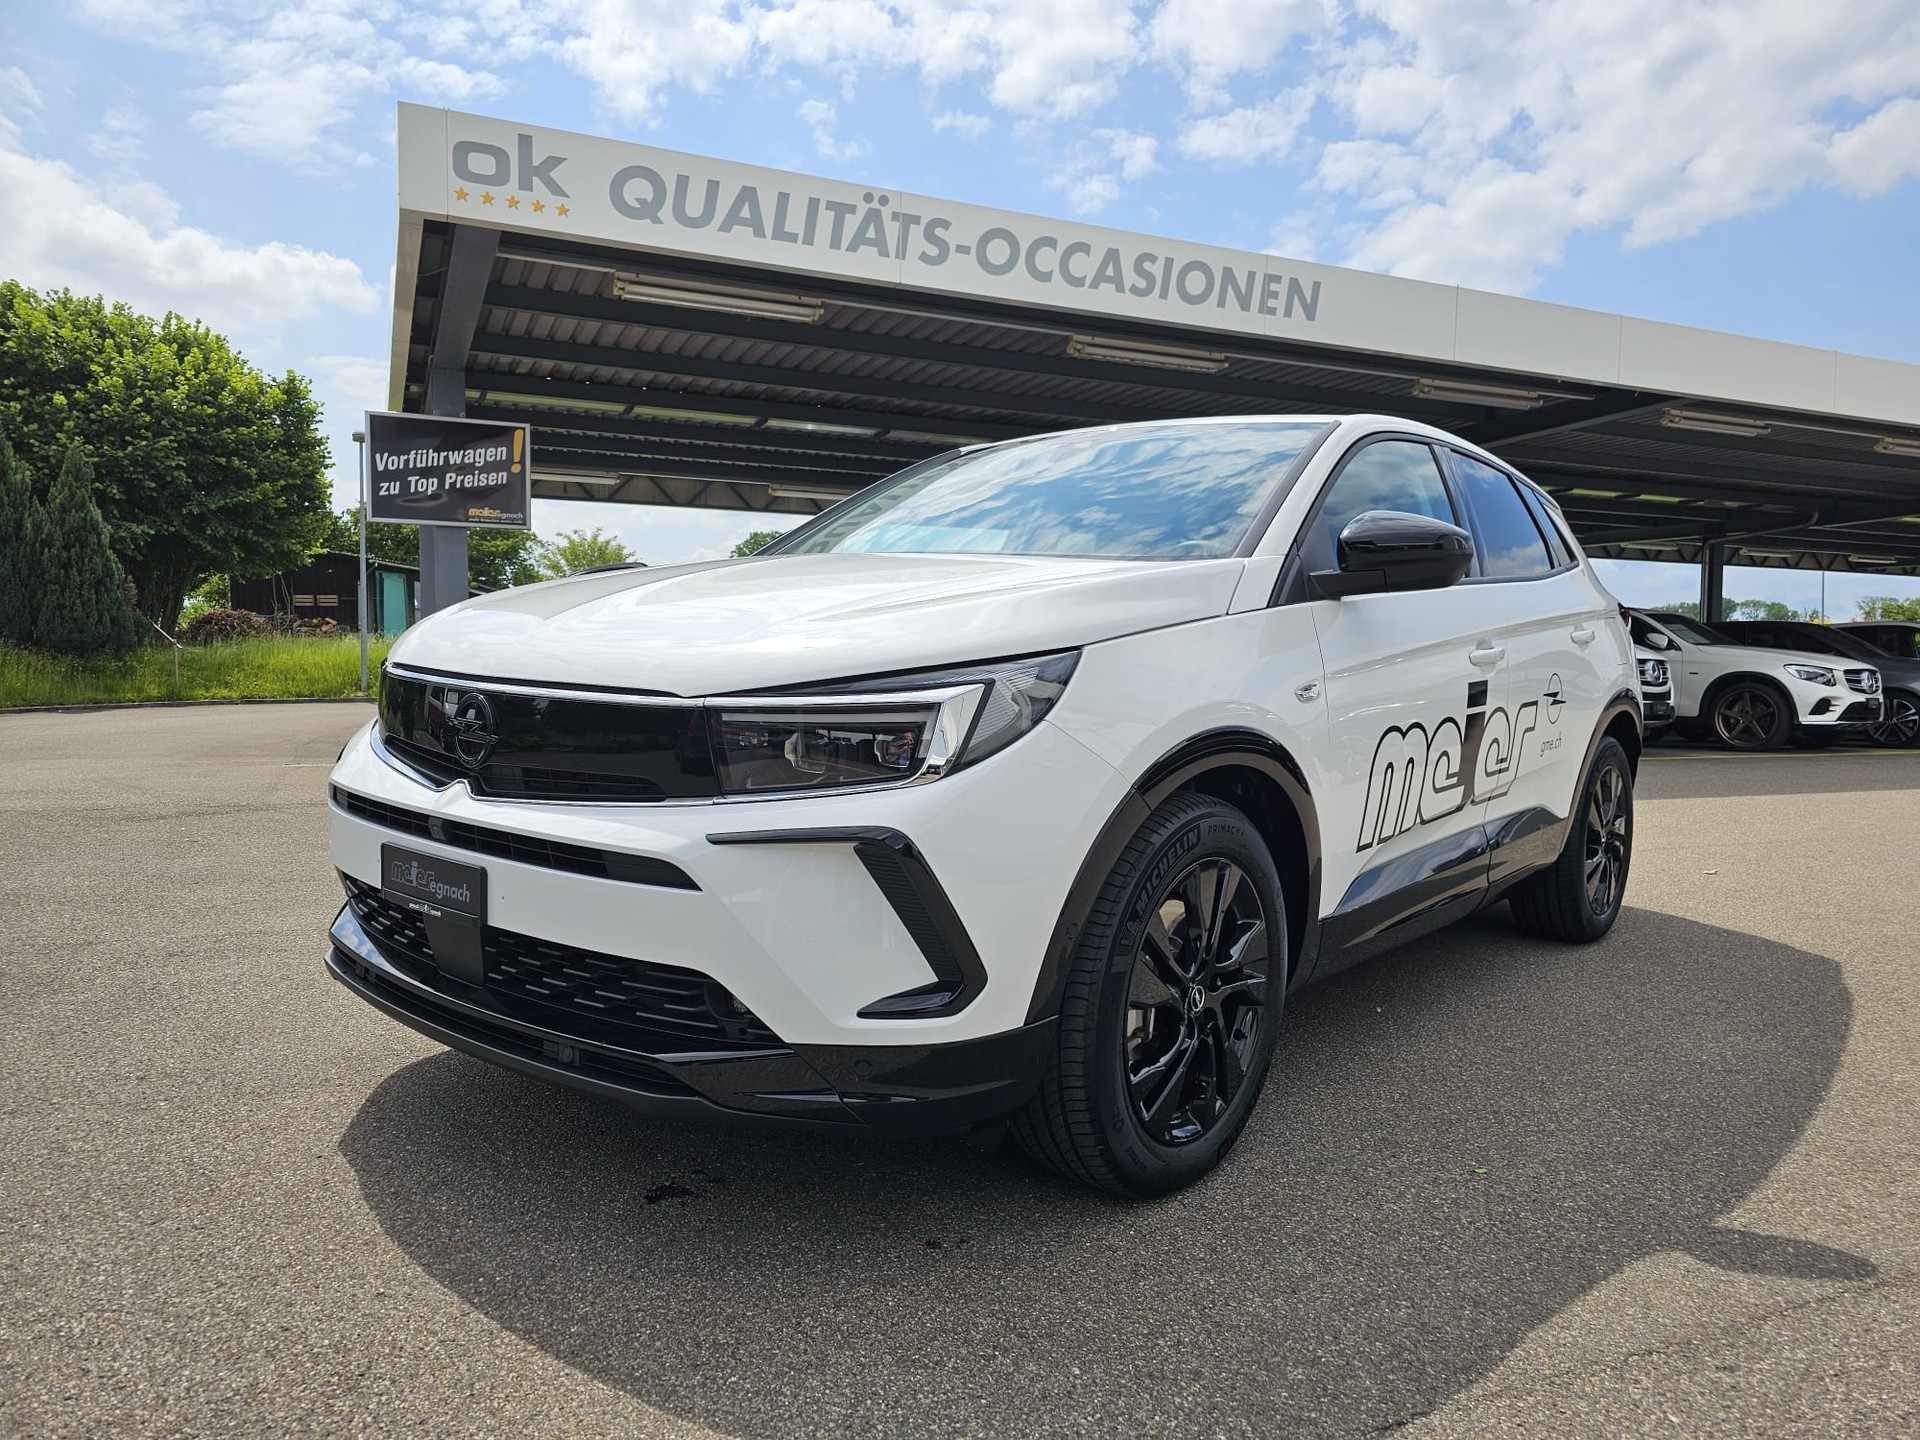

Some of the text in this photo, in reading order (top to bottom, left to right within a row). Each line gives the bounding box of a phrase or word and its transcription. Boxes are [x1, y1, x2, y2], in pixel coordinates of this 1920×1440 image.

[452, 133, 1322, 322] ok QUALITÄTS-OCCASIONEN
[375, 447, 507, 472] Vorführwagen
[379, 471, 507, 496] zu Top Preisen
[1355, 679, 1539, 854] meier
[1136, 828, 1201, 916] MICHELIN
